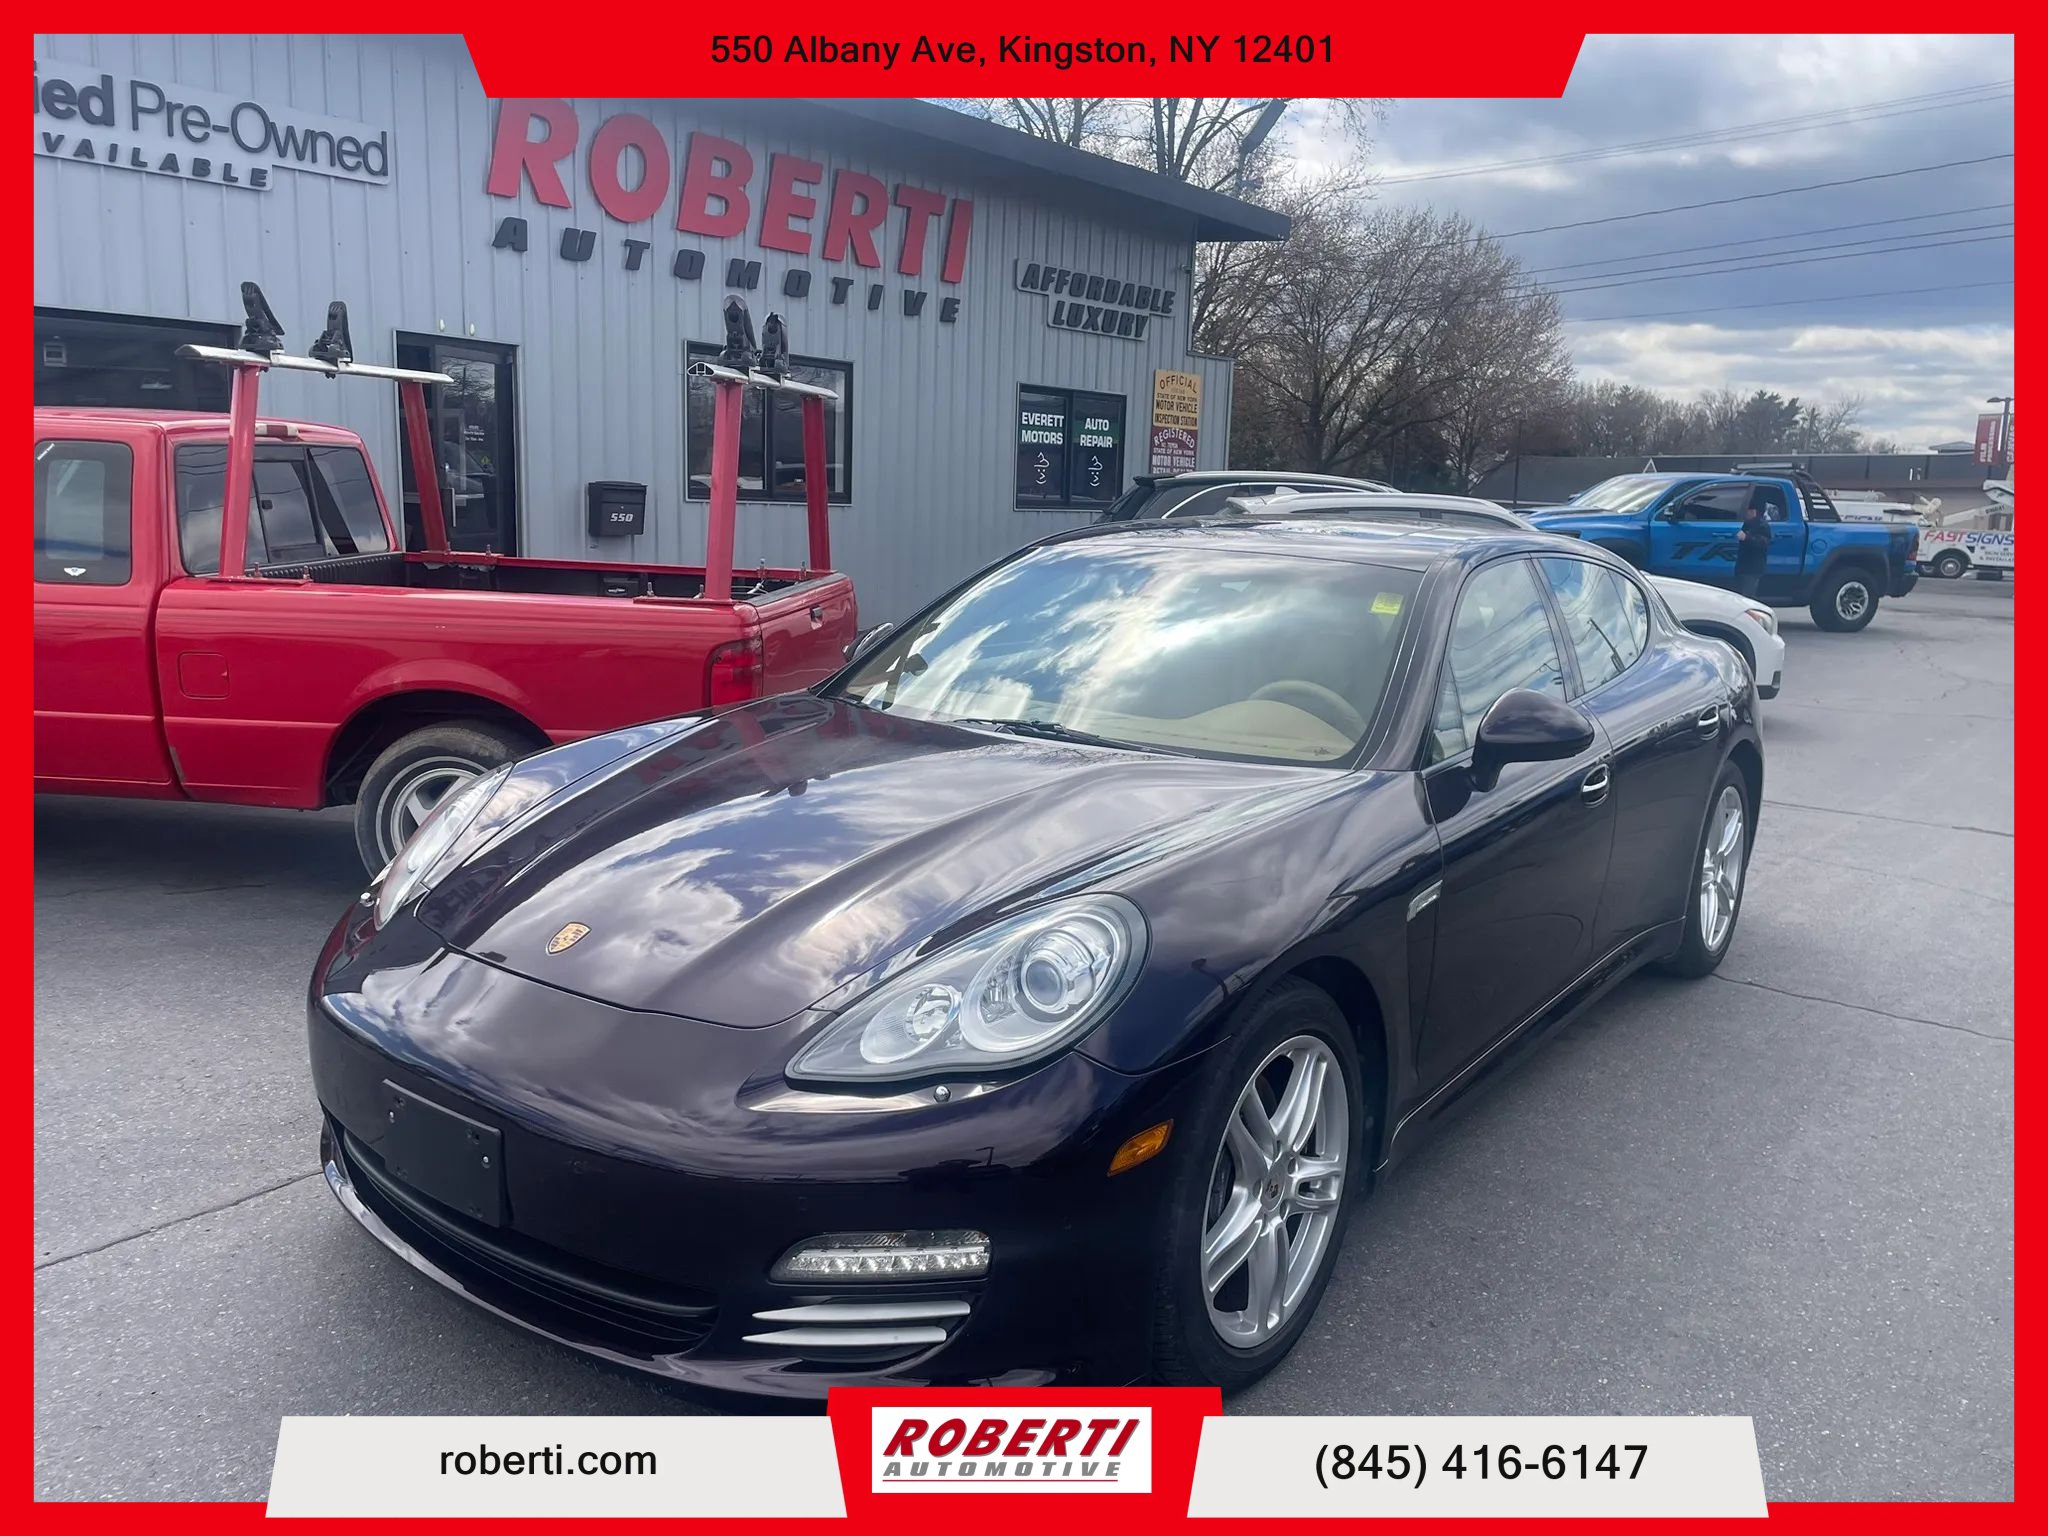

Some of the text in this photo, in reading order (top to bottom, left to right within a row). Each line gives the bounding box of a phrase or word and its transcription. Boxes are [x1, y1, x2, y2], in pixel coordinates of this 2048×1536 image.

[130, 79, 389, 177] Pre-Owned
[487, 98, 973, 284] ROBERTI
[492, 217, 961, 324] AUTOMOTIVE
[1021, 263, 1176, 314] AFFORDABLE
[1052, 300, 1149, 338] LUXURY
[1160, 375, 1198, 394] OFFICIAL
[1156, 399, 1198, 414] MOTOR VEHICLE
[1021, 411, 1064, 428] EVERETT
[1084, 417, 1109, 431] AUTO
[1155, 413, 1180, 425] INSPECTION
[1021, 429, 1063, 446] MOTORS
[1080, 434, 1113, 449] REPAIR
[1153, 428, 1195, 449] REGISTERED
[1172, 456, 1195, 468] VEHICLE
[610, 512, 634, 523] 550
